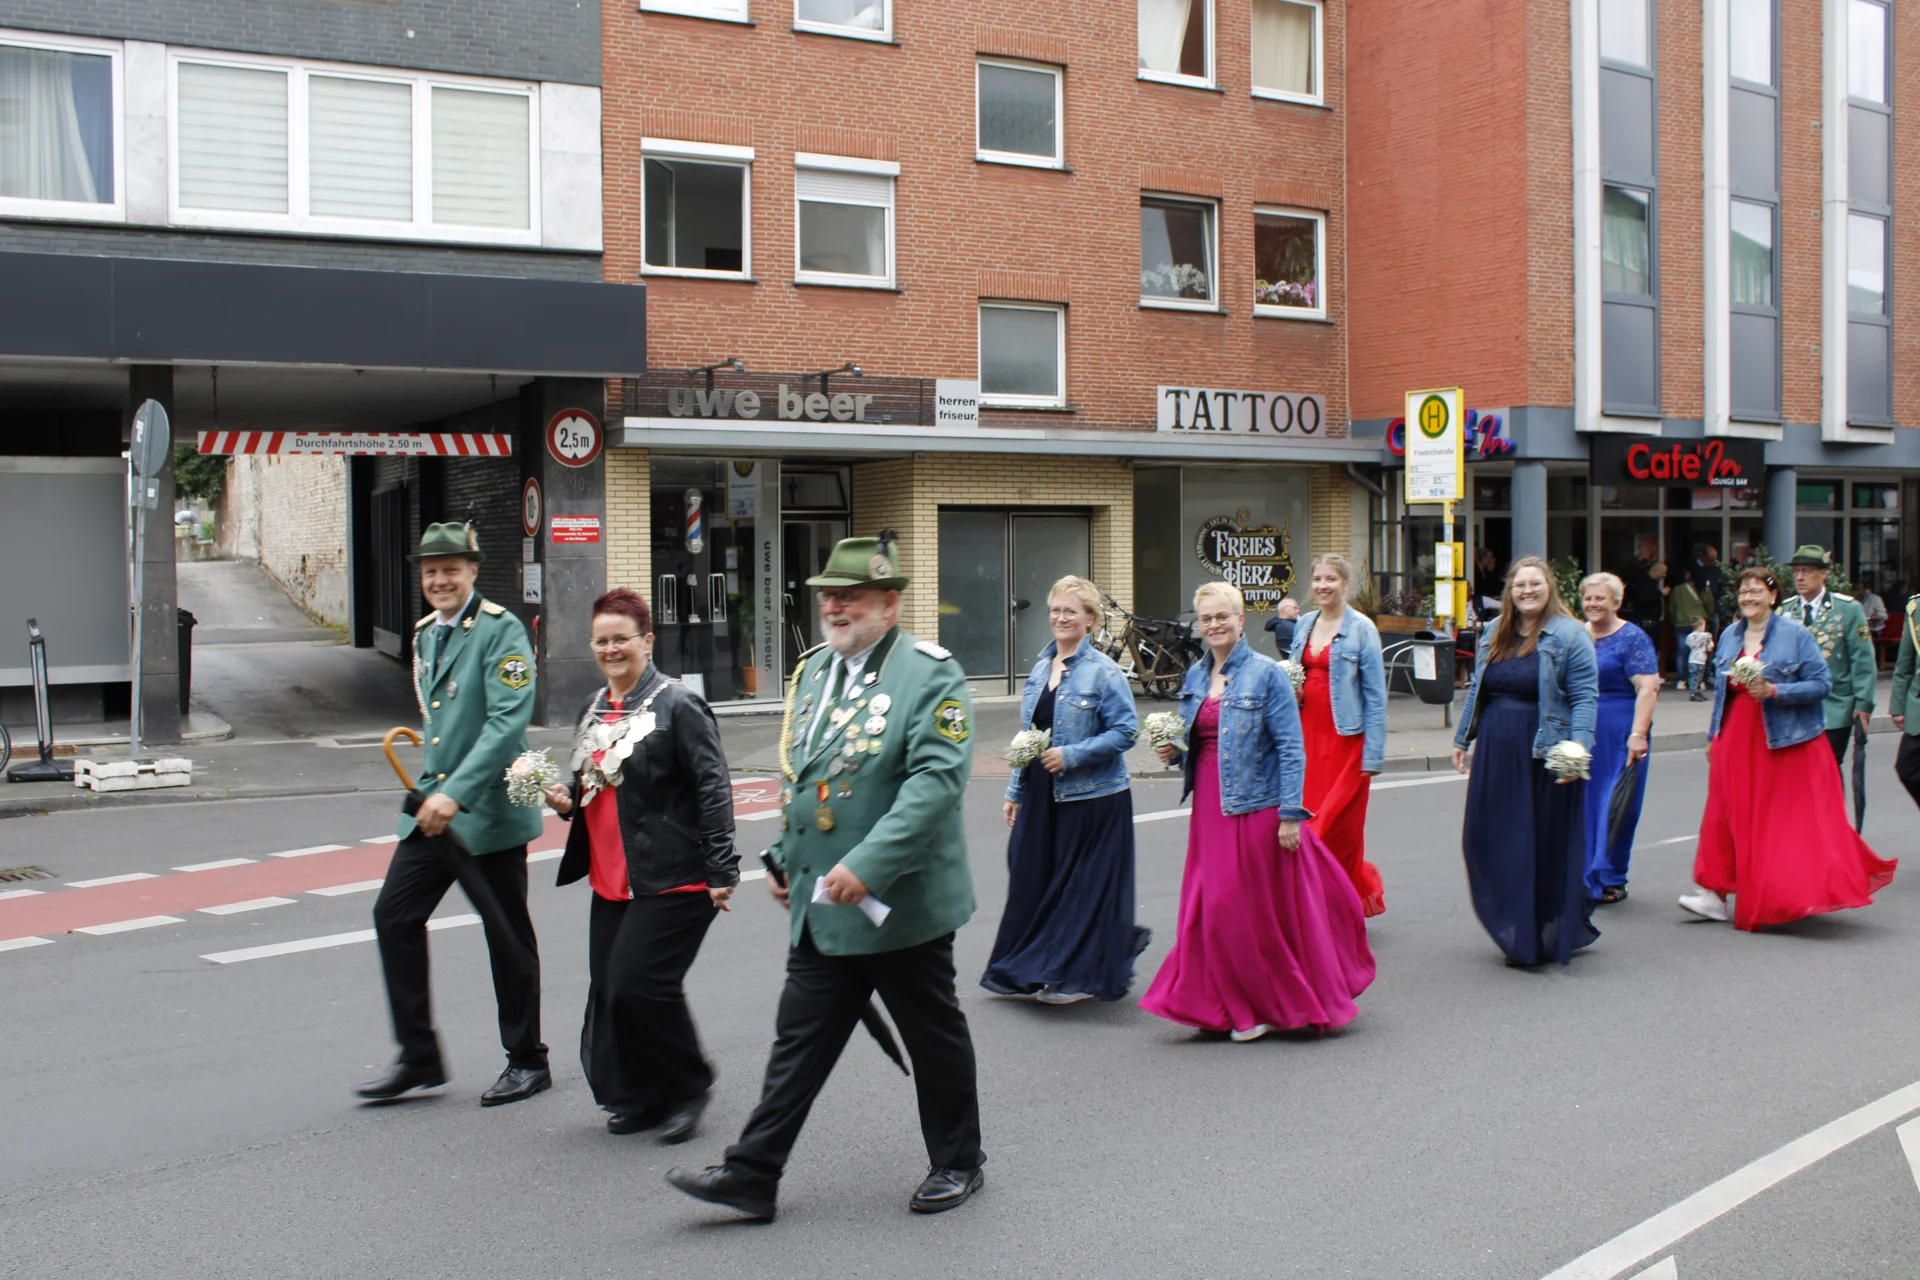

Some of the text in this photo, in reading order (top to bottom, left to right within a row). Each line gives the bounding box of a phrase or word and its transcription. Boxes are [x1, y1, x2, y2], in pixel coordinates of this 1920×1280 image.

[668, 384, 872, 421] uwe beer
[939, 395, 976, 406] herren
[1165, 389, 1320, 434] TATTOO
[939, 410, 977, 420] friseur.
[1428, 404, 1440, 428] H
[295, 438, 385, 449] Durchfahrtshöhe
[388, 439, 409, 449] 2,50
[560, 427, 590, 450] 2,5 m
[1211, 531, 1276, 562] FREIES
[1222, 559, 1273, 590] HERZ
[764, 577, 772, 611] beer
[1243, 589, 1281, 601] TATTOO
